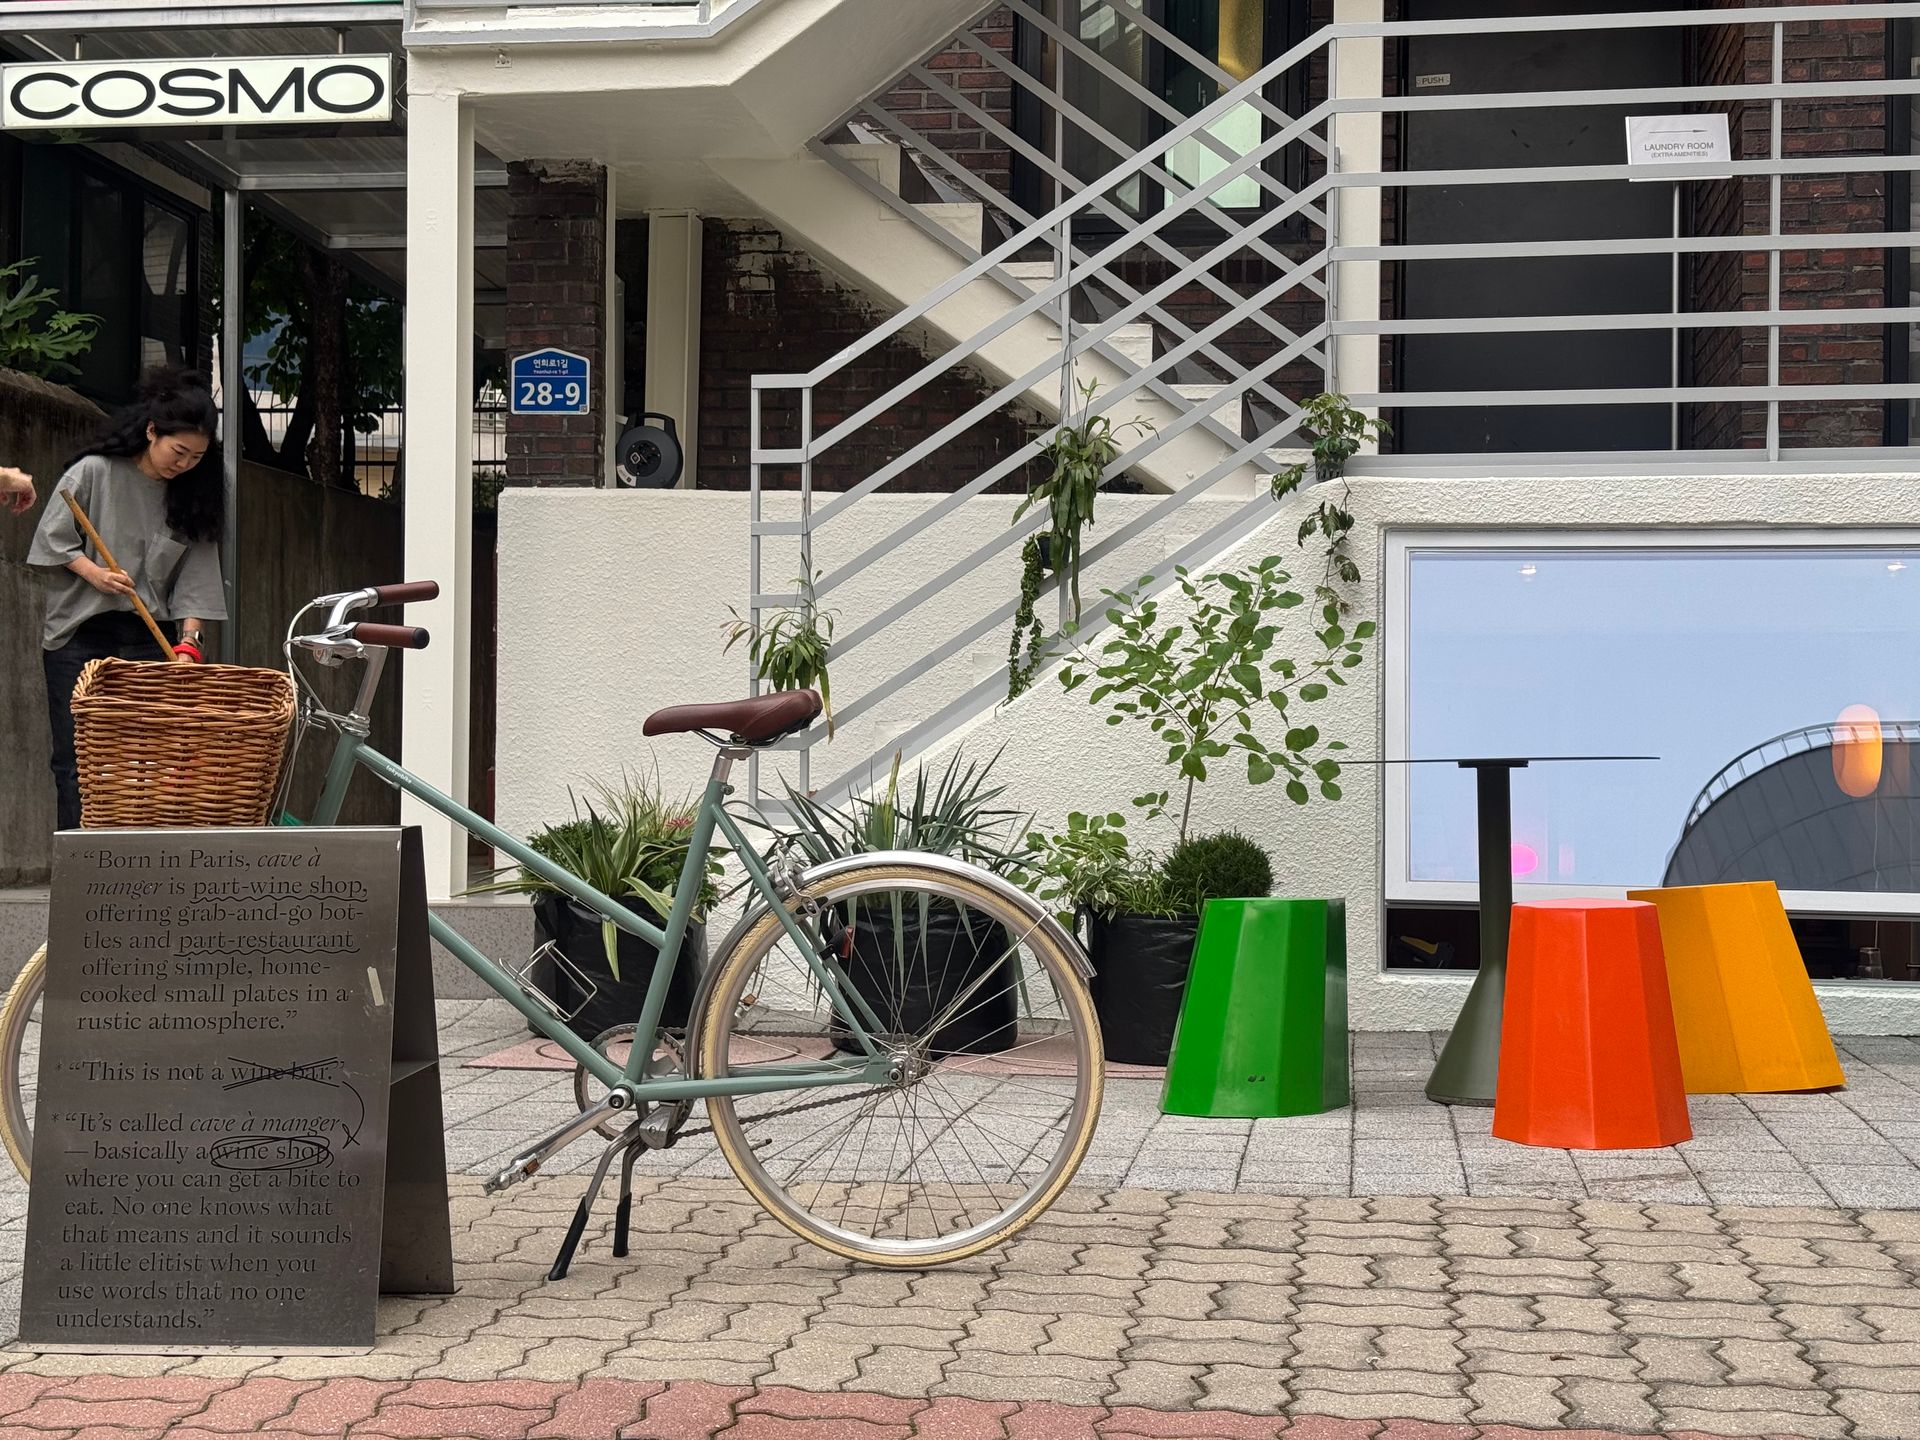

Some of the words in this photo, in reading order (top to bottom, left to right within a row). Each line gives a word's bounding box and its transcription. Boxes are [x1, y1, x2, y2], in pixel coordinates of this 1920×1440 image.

[1422, 76, 1443, 84] PUSH
[10, 64, 385, 120] COSMO
[1645, 143, 1685, 151] LAUNDRY
[1687, 142, 1714, 150] ROOM
[533, 359, 568, 368] 연희로1길
[521, 382, 580, 405] 28-9
[84, 849, 151, 869] “Born
[160, 849, 181, 868] in
[190, 849, 249, 871] Paris,
[258, 854, 302, 868] cave
[308, 847, 321, 867] à
[87, 882, 163, 897] manger
[169, 878, 185, 895] is
[193, 878, 302, 899] part-wine
[310, 876, 368, 898] shop,
[85, 904, 171, 925] offering
[178, 904, 312, 925] grab-and-go
[319, 903, 363, 921] bot-
[84, 931, 121, 949] tles
[130, 930, 171, 948] and
[179, 931, 354, 952] part-restaurant
[82, 958, 167, 980] offering
[174, 958, 252, 979] simple,
[260, 957, 330, 975] home-
[80, 985, 156, 1003] cooked
[165, 985, 224, 1002] small
[232, 985, 298, 1006] plates
[307, 985, 328, 1002] in
[336, 989, 347, 1002] a
[77, 1011, 141, 1030] rustic
[149, 1010, 298, 1035] atmosphere.”
[70, 1061, 134, 1081] “This
[143, 1063, 159, 1081] is
[168, 1064, 204, 1081] not
[212, 1067, 224, 1081] a
[232, 1063, 284, 1081] wine
[66, 1113, 112, 1132] “It’s
[120, 1113, 183, 1132] called
[191, 1117, 234, 1131] cave
[241, 1111, 254, 1131] à
[262, 1117, 340, 1136] manger
[95, 1141, 188, 1163] basically
[196, 1147, 211, 1160] a
[218, 1141, 268, 1160] wine
[276, 1141, 328, 1163] shop
[65, 1169, 128, 1188] where
[136, 1173, 174, 1191] you
[183, 1173, 221, 1188] can
[229, 1171, 261, 1191] get
[269, 1174, 281, 1188] a
[288, 1169, 329, 1188] bite
[339, 1170, 360, 1188] to
[65, 1199, 103, 1215] eat.
[112, 1197, 145, 1215] No
[153, 1200, 192, 1215] one
[200, 1196, 269, 1215] knows
[278, 1196, 333, 1215] what
[63, 1225, 107, 1243] that
[116, 1229, 188, 1243] means
[197, 1225, 238, 1243] and
[248, 1225, 263, 1243] it
[271, 1225, 351, 1244] sounds
[61, 1257, 72, 1272] a
[80, 1252, 130, 1272] little
[139, 1252, 202, 1272] elitist
[210, 1253, 268, 1272] when
[276, 1257, 316, 1277] you
[59, 1286, 93, 1300] use
[102, 1281, 167, 1300] words
[176, 1281, 222, 1300] that
[231, 1286, 257, 1300] no
[266, 1286, 305, 1300] one
[56, 1308, 214, 1329] understands.”
